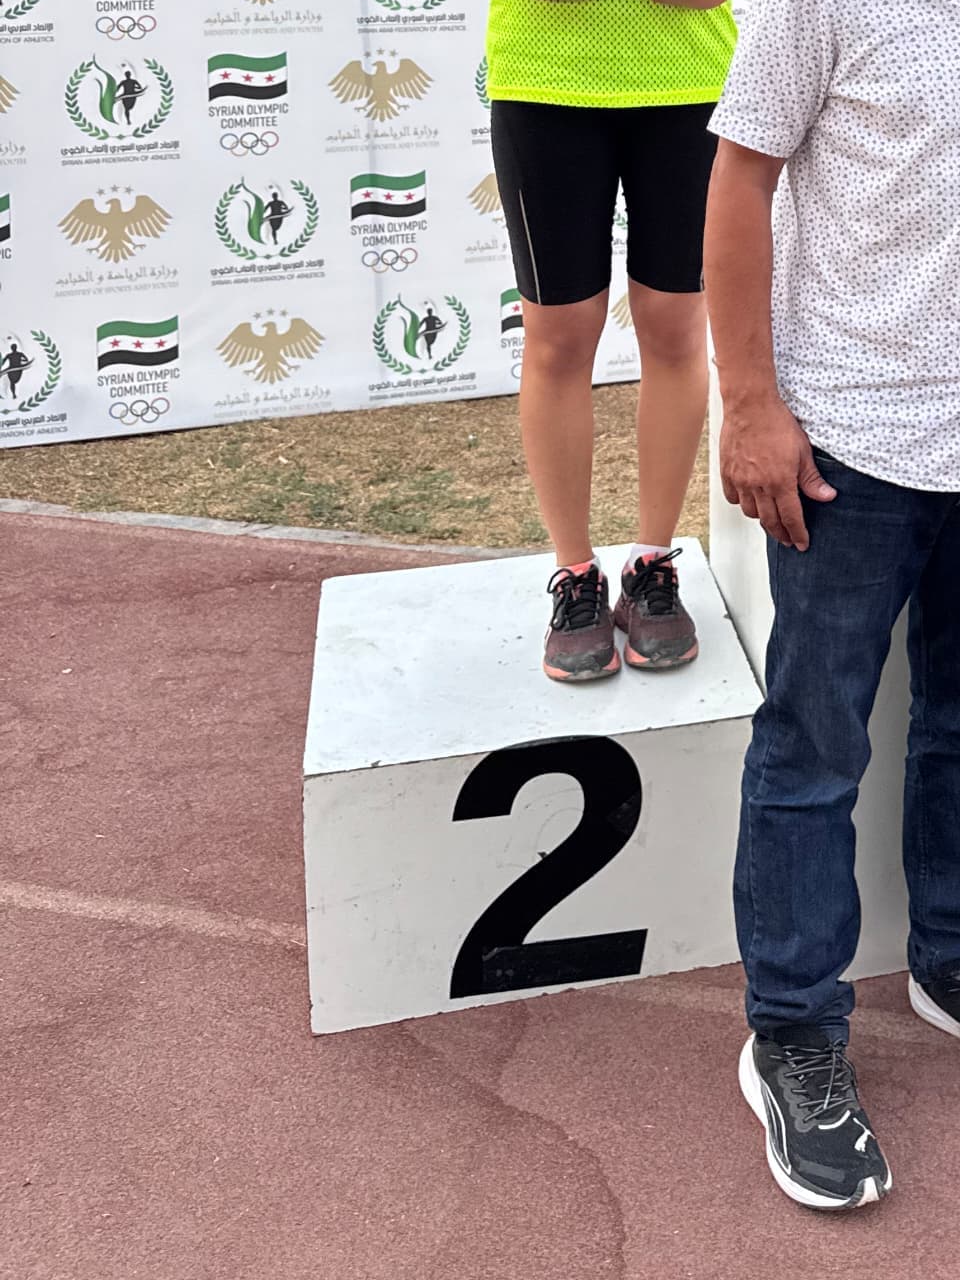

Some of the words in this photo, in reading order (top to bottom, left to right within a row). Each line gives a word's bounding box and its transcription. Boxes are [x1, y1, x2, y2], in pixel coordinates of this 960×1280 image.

[96, 0, 155, 12] COMMITTEE
[208, 105, 245, 117] SYRIAN
[246, 103, 289, 115] OLYMPIC
[221, 116, 278, 129] COMMITTEE
[350, 224, 385, 236] SYRIAN
[387, 219, 428, 233] OLYMPIC
[362, 233, 417, 247] COMMITTEE
[501, 336, 525, 348] SYRI
[97, 373, 134, 387] SYRIAN
[137, 368, 180, 382] OLYMPIC
[110, 381, 168, 398] COMMITTEE
[450, 735, 648, 1000] 2
